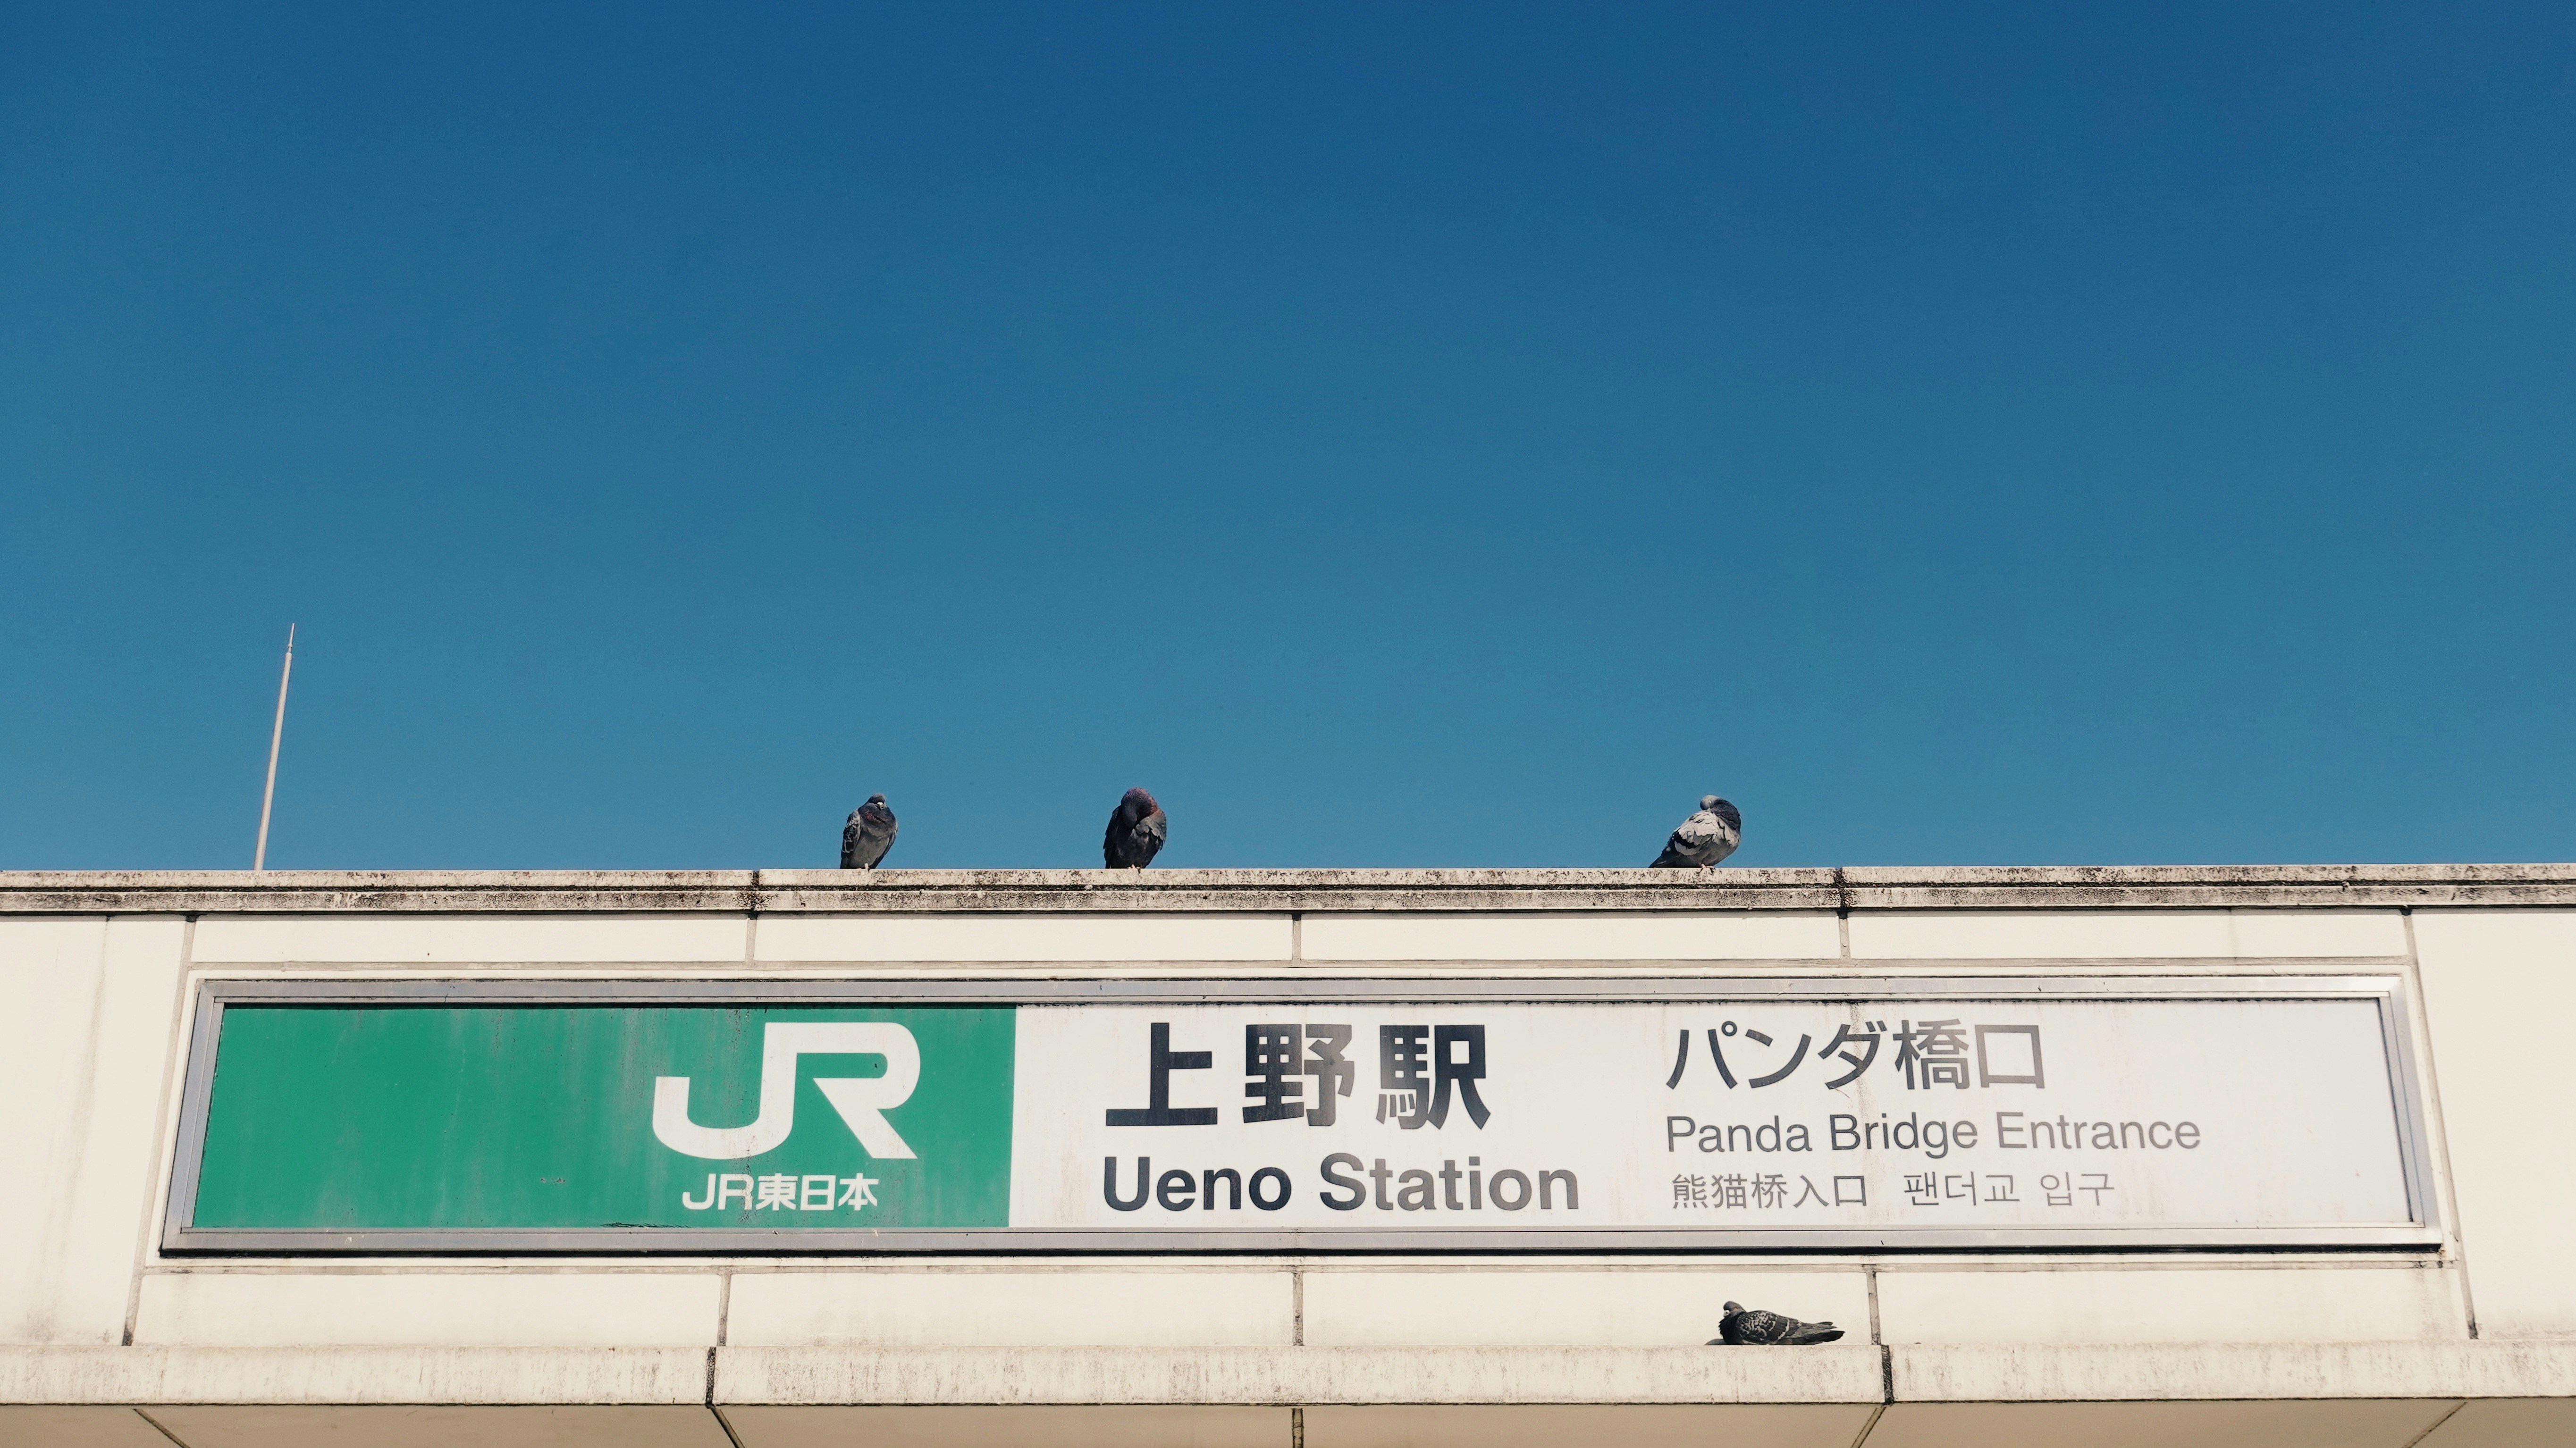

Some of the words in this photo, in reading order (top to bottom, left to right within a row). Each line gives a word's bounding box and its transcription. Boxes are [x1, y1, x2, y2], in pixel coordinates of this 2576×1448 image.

[1105, 1022, 1491, 1130] 上野駅
[1666, 1018, 2046, 1090] パンダ橋口
[653, 1022, 921, 1160] JR
[1667, 1115, 1812, 1153] Panda
[1830, 1111, 1977, 1159] Bridge
[1996, 1111, 2200, 1150] Entrance
[682, 1172, 879, 1211] JR東日本
[1103, 1156, 1292, 1211] Ueno
[1319, 1152, 1579, 1212] Station
[1672, 1173, 1867, 1209] 熊猫桥入口
[1903, 1170, 2020, 1207] 팬더교
[2039, 1172, 2115, 1207] 입구
